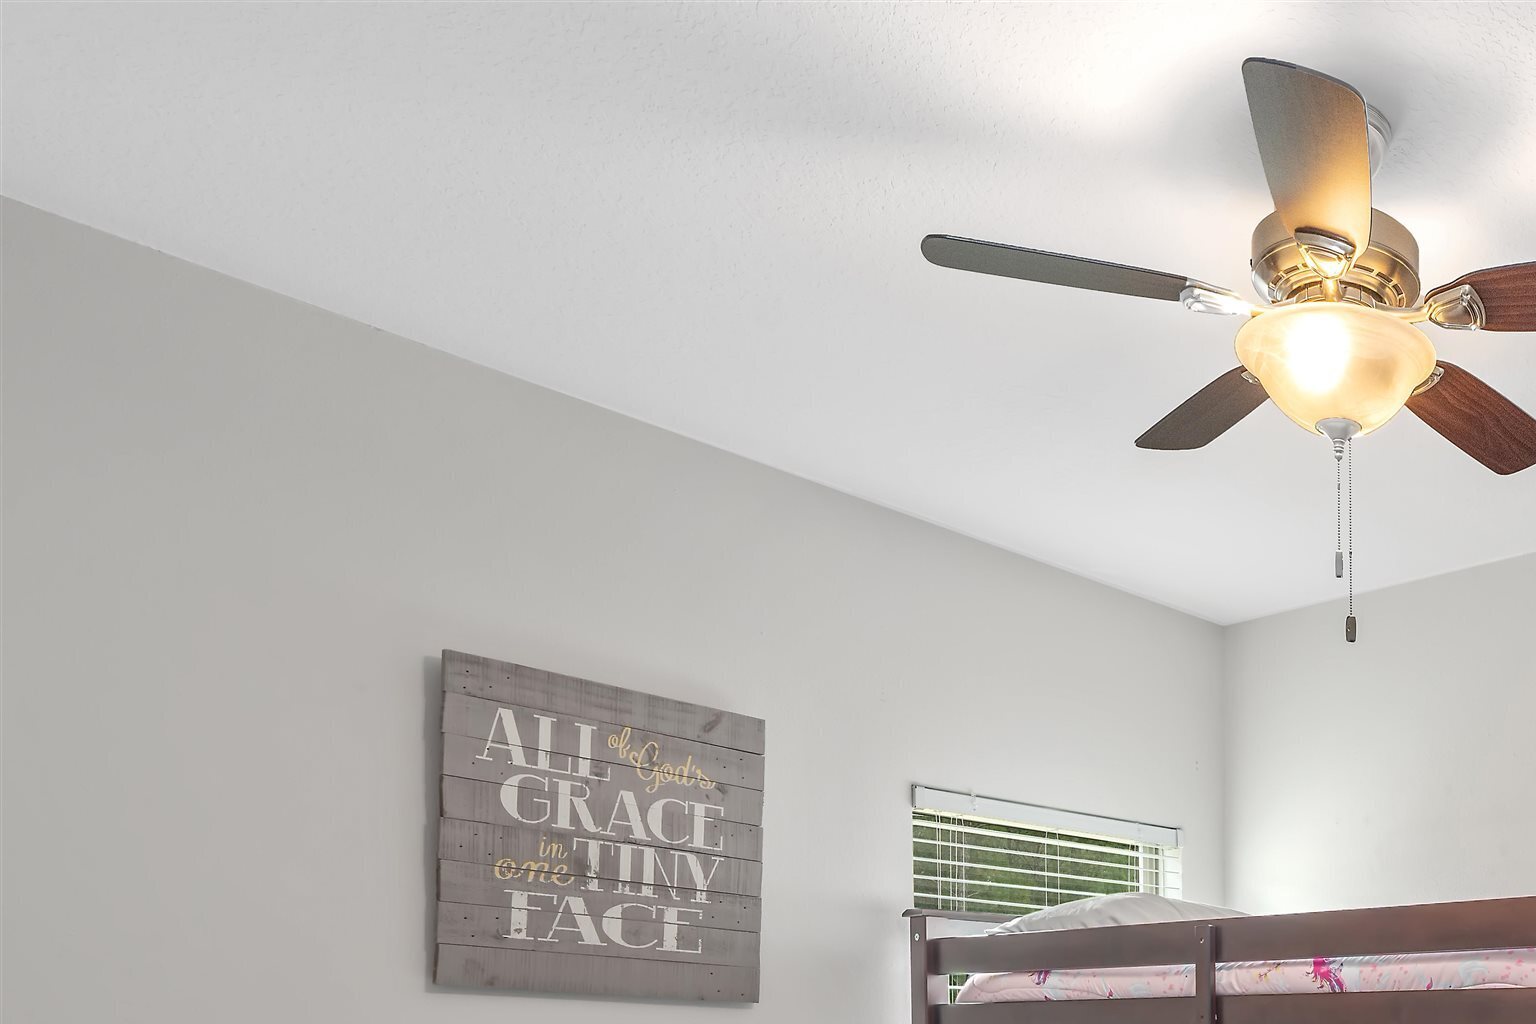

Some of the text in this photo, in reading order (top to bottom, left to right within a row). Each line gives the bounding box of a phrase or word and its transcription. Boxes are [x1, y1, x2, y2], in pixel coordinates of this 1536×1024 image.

[475, 707, 611, 781] ALL
[608, 725, 716, 794] of God's
[500, 773, 725, 851] GRACE
[494, 858, 575, 886] one
[539, 836, 568, 860] in
[573, 837, 726, 904] TINY
[501, 889, 703, 954] FACE
